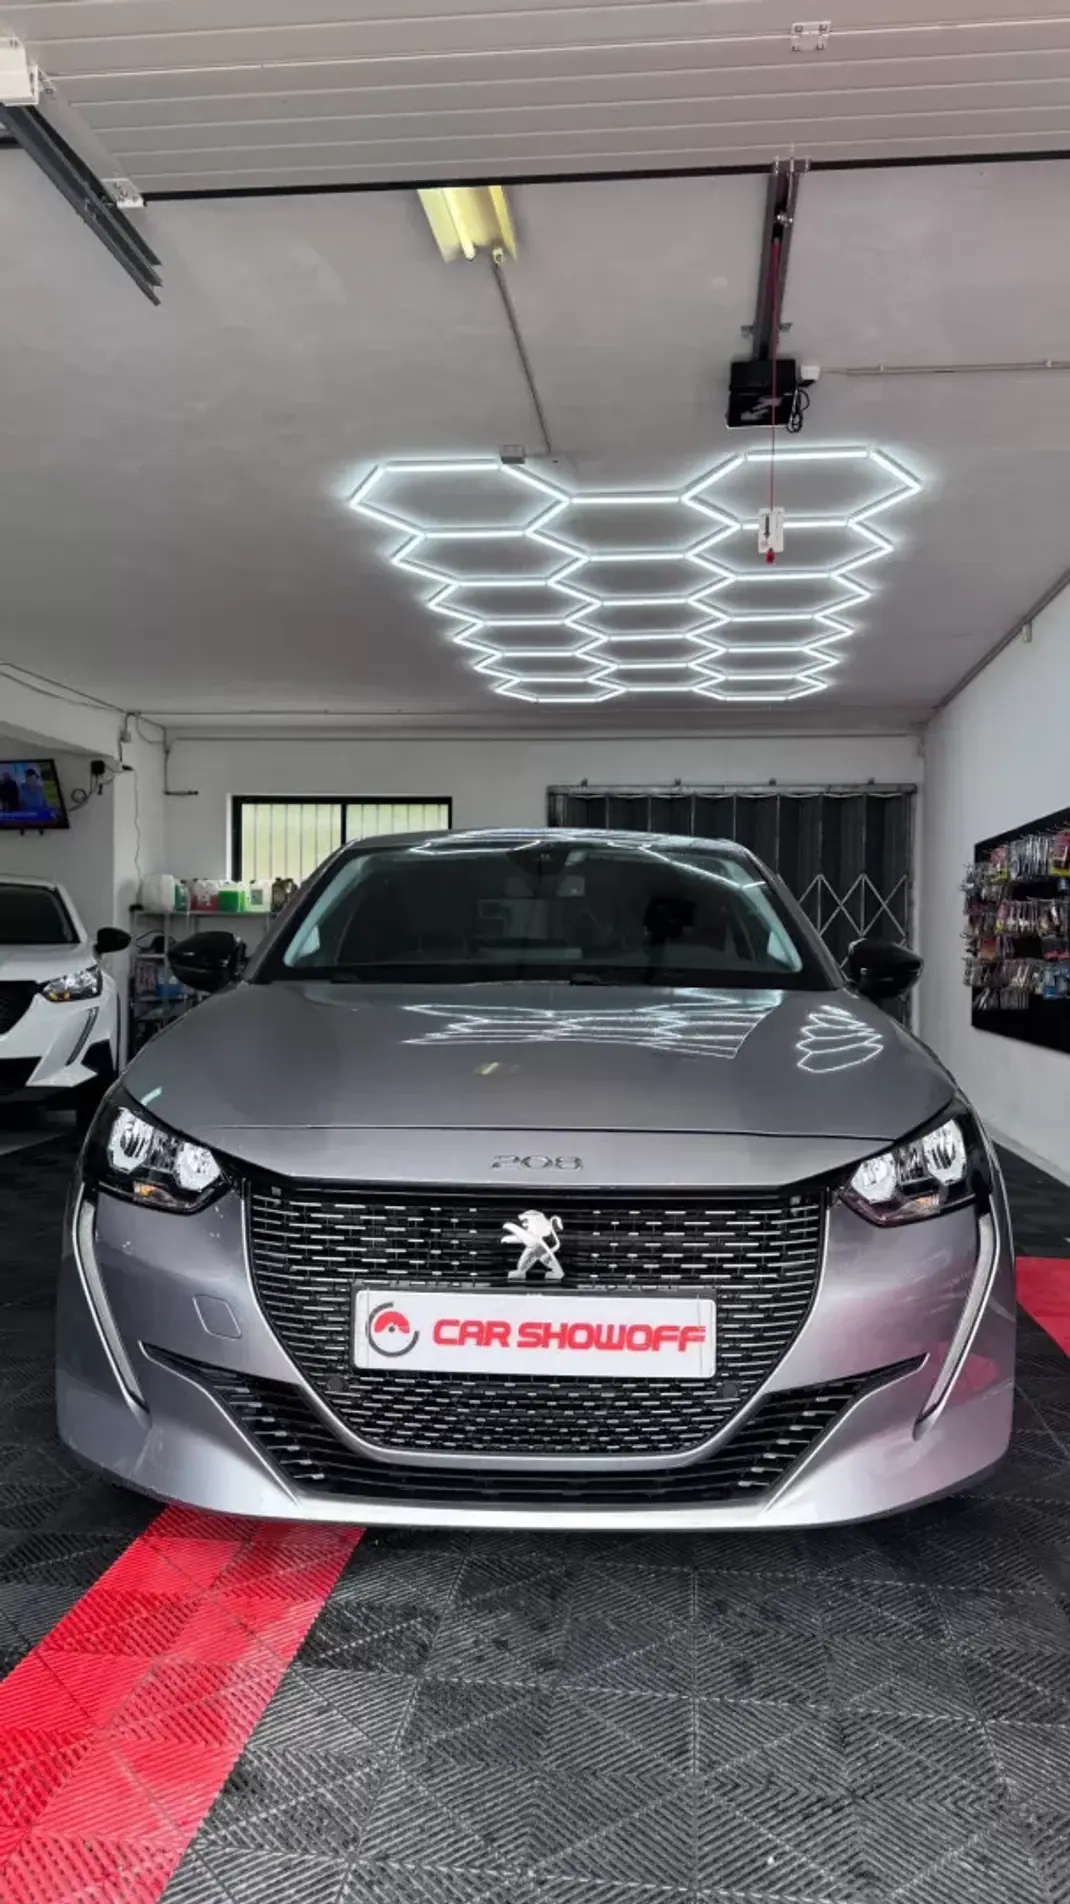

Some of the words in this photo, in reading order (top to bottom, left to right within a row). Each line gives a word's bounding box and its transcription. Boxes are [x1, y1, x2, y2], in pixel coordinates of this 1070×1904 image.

[491, 1154, 583, 1170] 208
[432, 1318, 512, 1348] CAR
[516, 1321, 707, 1353] SHOWOFF
